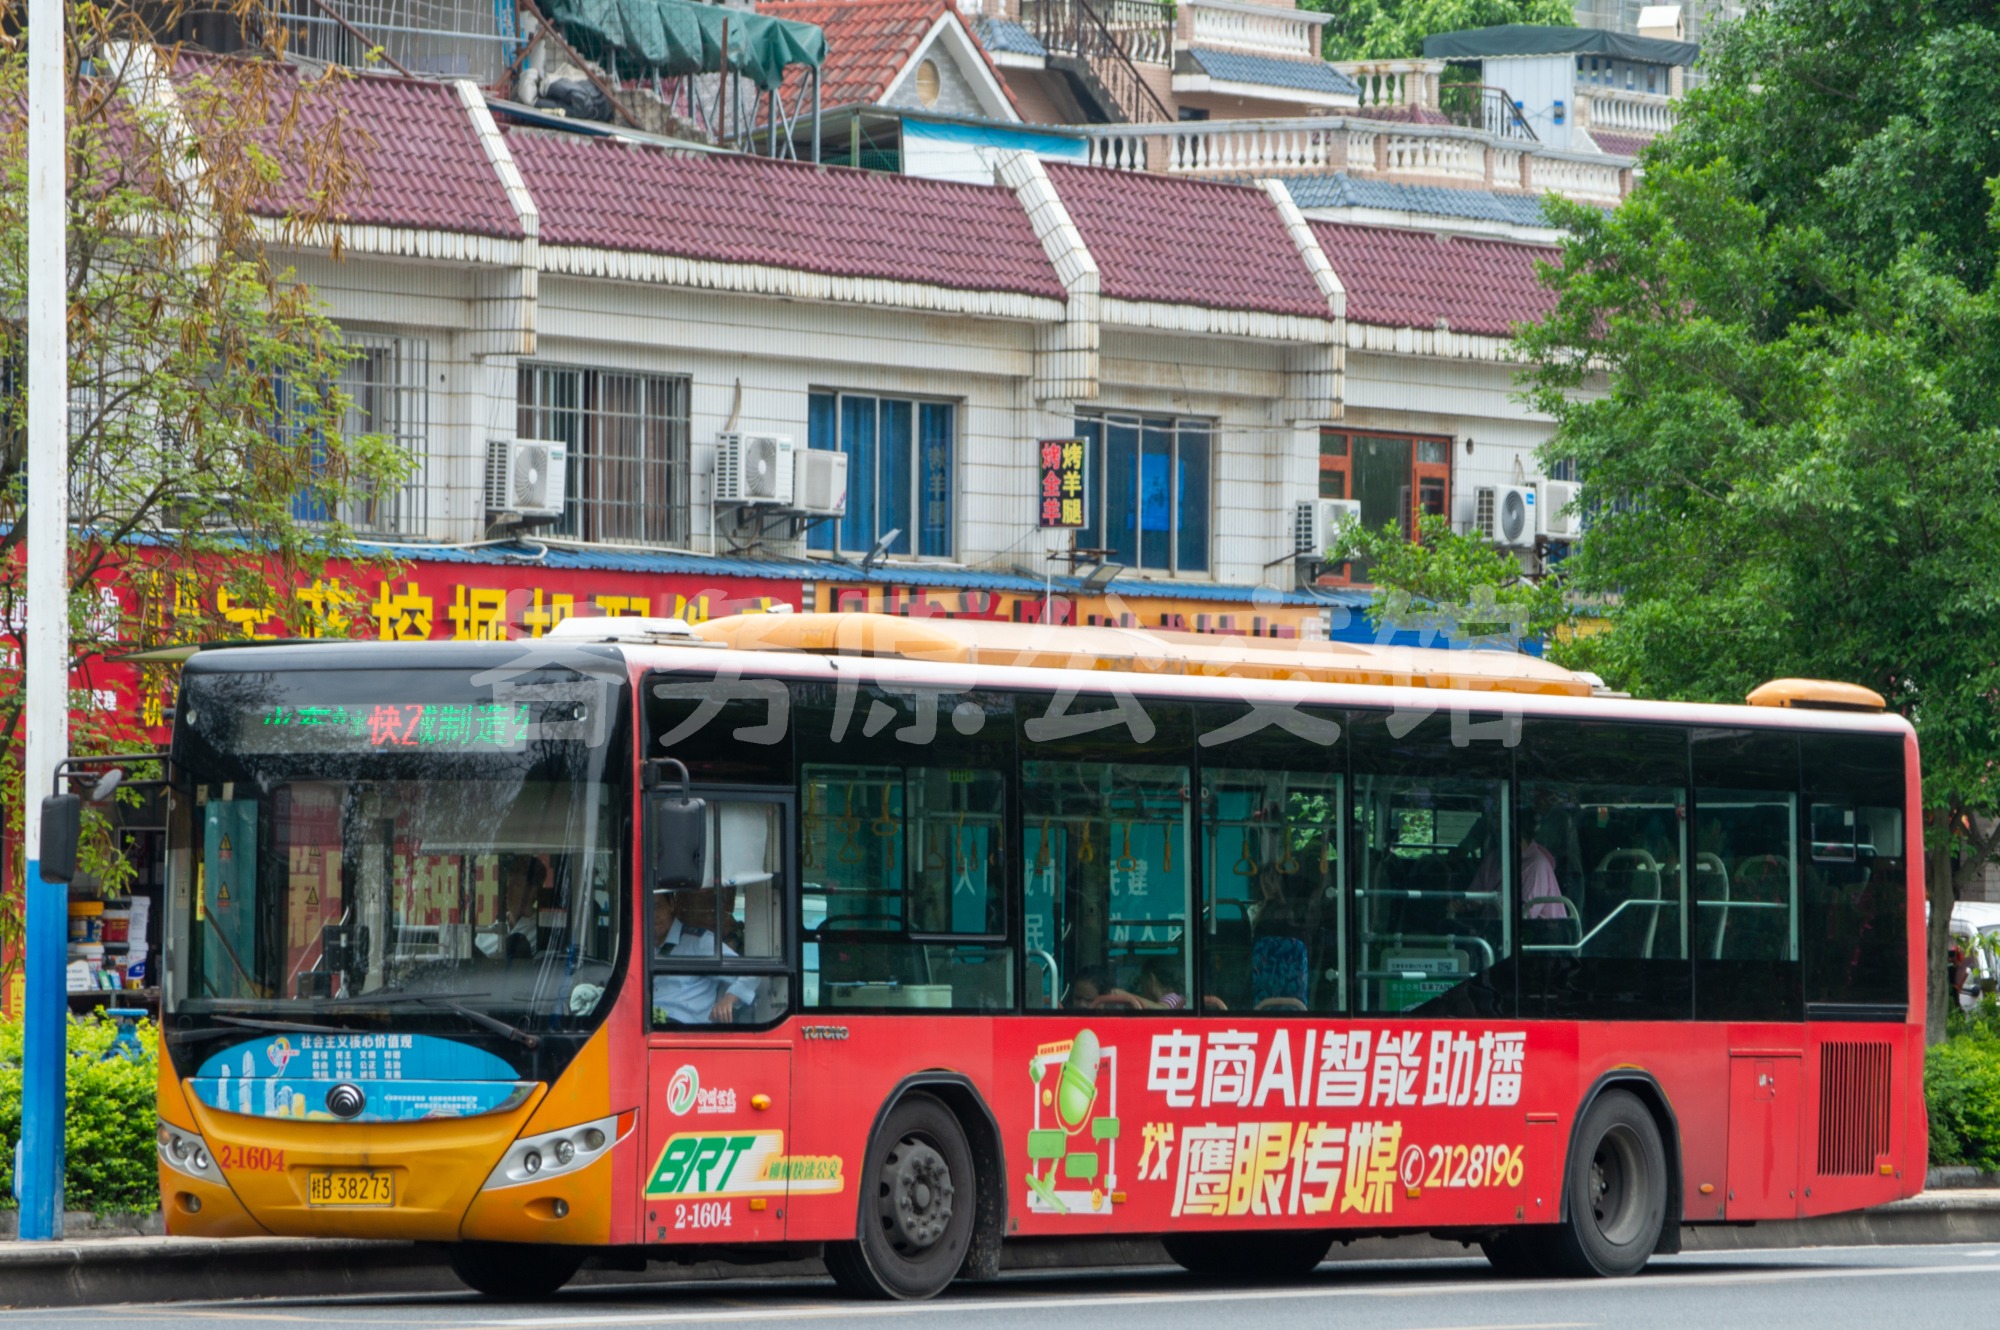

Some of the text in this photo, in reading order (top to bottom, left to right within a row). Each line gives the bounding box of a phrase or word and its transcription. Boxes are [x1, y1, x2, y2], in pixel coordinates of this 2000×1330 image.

[1042, 443, 1061, 525] 烤全羊
[1062, 443, 1082, 525] 烤羊腿
[301, 1034, 412, 1049] 社会主义核心价值观
[1146, 1029, 1526, 1107] 电商AI智能助播
[221, 1145, 286, 1173] 2-1604
[646, 1136, 757, 1194] BRT
[1138, 1120, 1402, 1217] 找鹰眼传媒
[1424, 1144, 1524, 1188] 2128196
[675, 1202, 732, 1230] 2-1604
